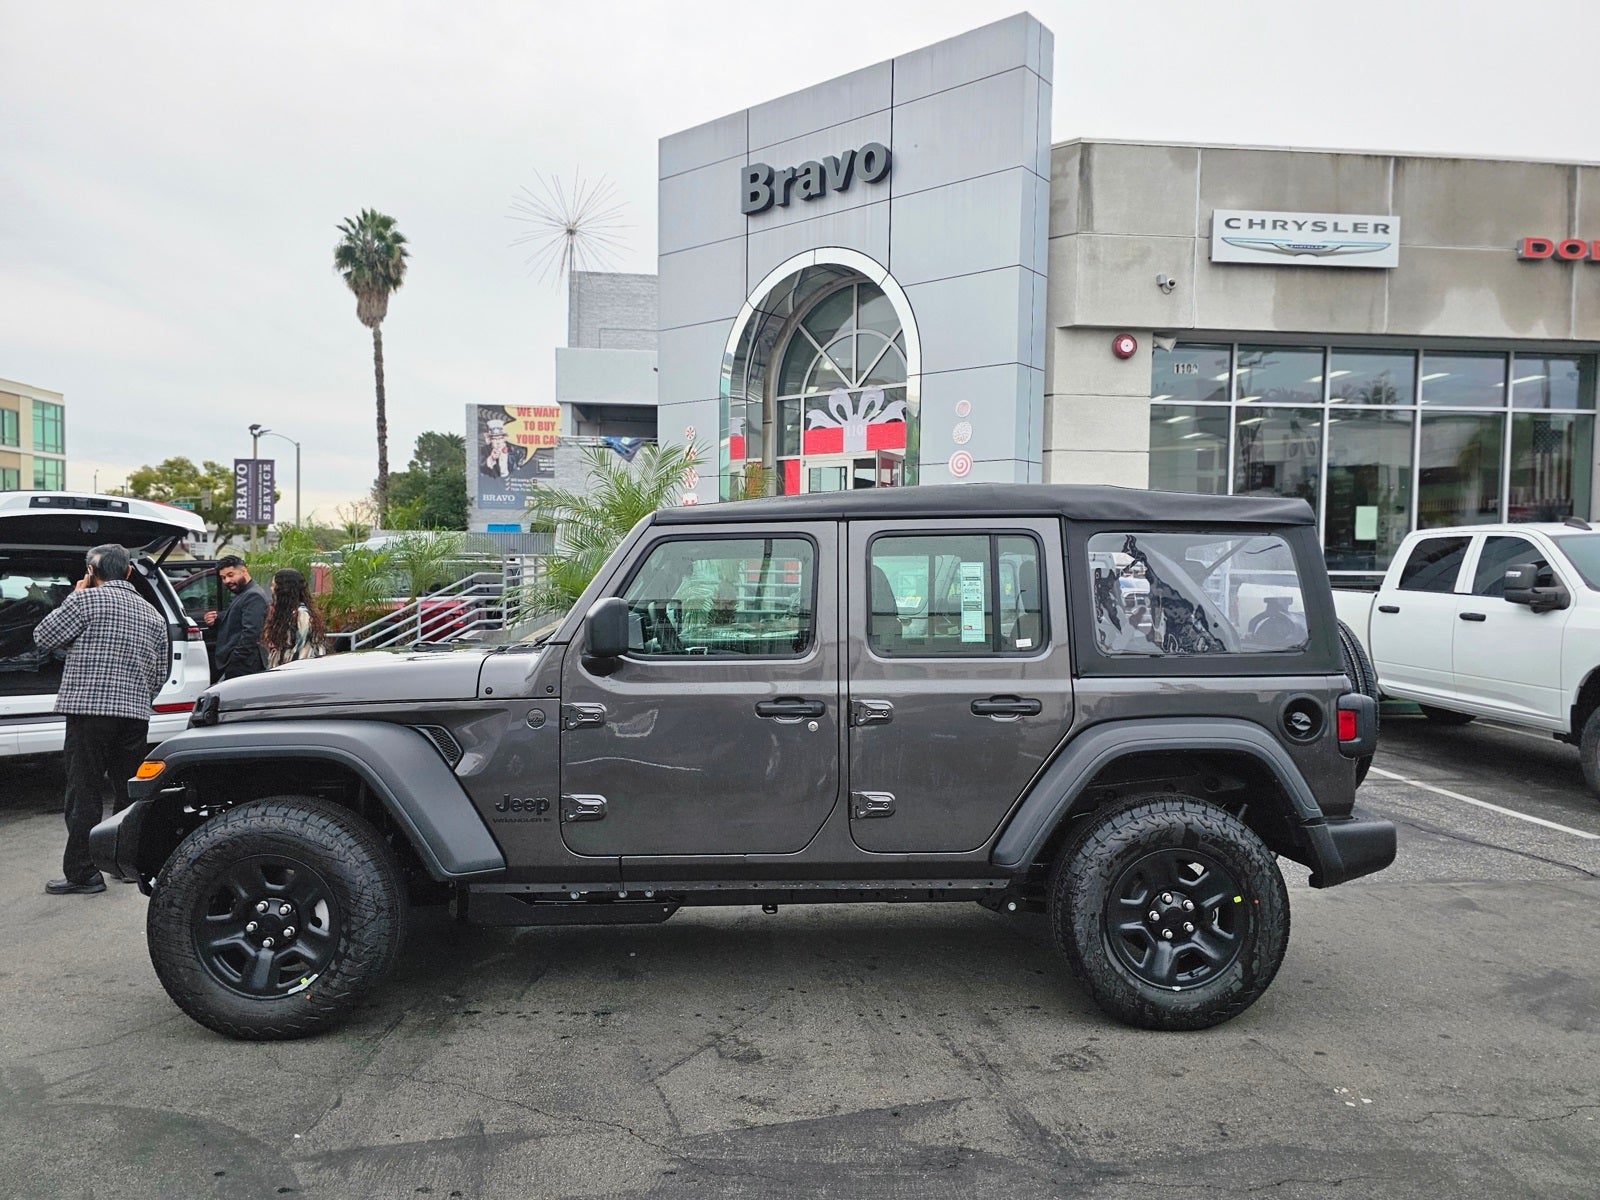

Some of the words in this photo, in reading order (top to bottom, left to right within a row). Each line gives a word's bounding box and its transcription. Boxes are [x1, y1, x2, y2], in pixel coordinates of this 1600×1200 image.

[741, 142, 892, 215] Bravo
[1224, 217, 1391, 235] CHRYSLER
[1518, 237, 1600, 260] DO
[516, 407, 533, 417] WE
[534, 407, 560, 418] WANT
[524, 421, 536, 431] TO
[537, 421, 556, 431] BUY
[516, 434, 540, 445] YOUR
[236, 463, 248, 519] BRAVO
[263, 464, 271, 520] SERVICE
[482, 494, 515, 502] BRAVO
[495, 793, 550, 816] Jeep
